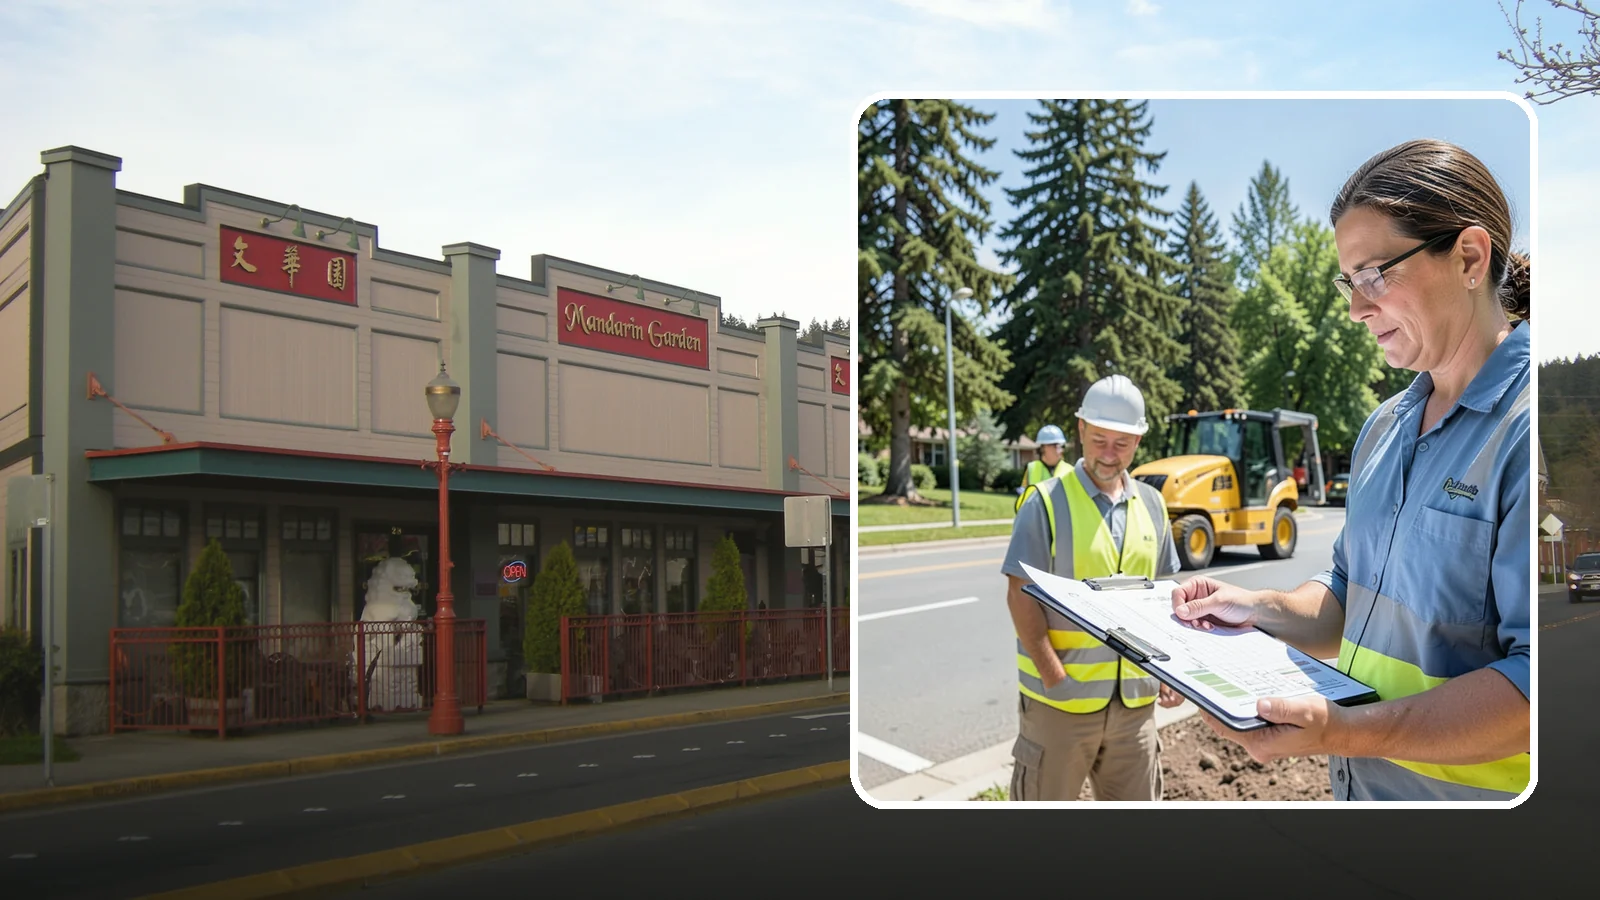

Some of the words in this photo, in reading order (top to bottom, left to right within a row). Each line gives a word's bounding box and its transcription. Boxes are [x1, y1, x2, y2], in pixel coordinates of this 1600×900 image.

[230, 235, 346, 291] 文華園
[564, 302, 644, 341] Mandarin
[648, 320, 702, 352] Garden
[503, 565, 527, 578] OPEN
